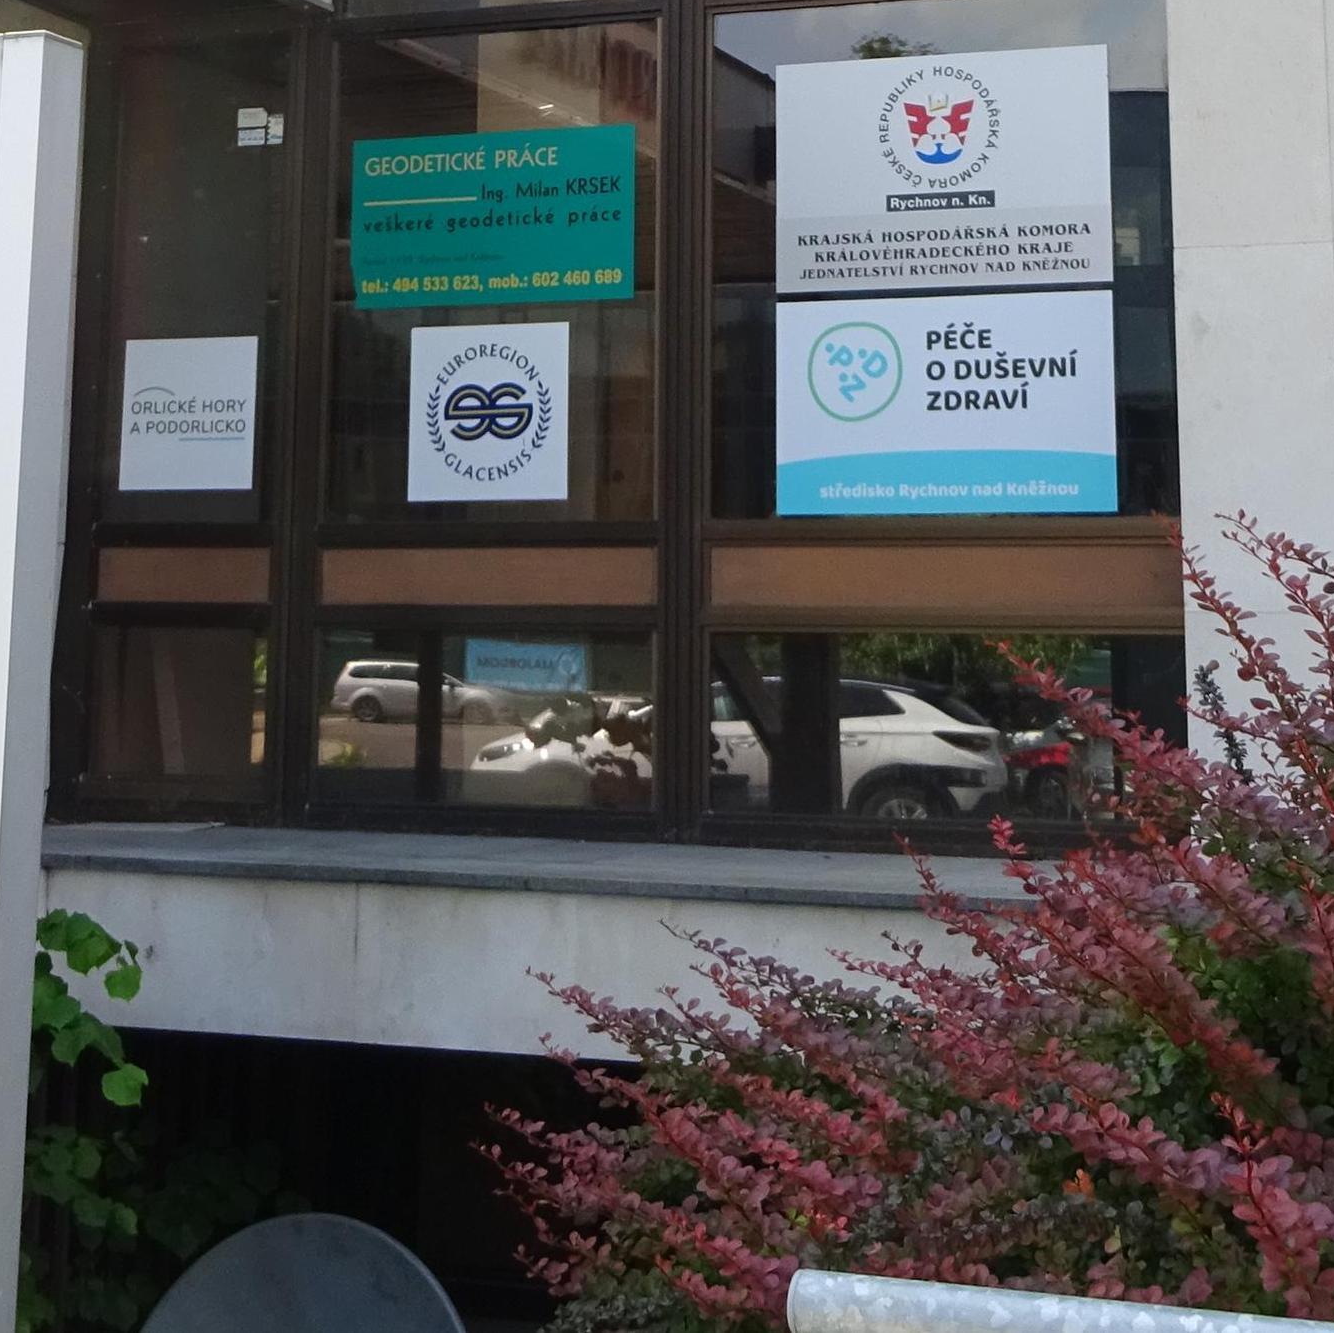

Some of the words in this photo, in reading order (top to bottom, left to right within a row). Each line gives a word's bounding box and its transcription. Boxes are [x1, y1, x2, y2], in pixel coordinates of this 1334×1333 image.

[879, 70, 924, 143] REPUBLIKY
[934, 66, 1000, 149] HOSPODÁŘSKÁ
[366, 146, 485, 176] GEODETICKÉ
[495, 143, 558, 167] PRÁCE
[880, 148, 922, 187] ČESKÉ
[929, 153, 989, 189] KOMORA
[482, 183, 508, 203] Ing.
[517, 182, 558, 197] Milan
[566, 176, 620, 195] KRSEK
[890, 195, 947, 210] Rychnov
[952, 197, 964, 207] n.
[968, 194, 990, 206] Kn.
[364, 209, 433, 234] veškeré
[447, 206, 554, 232] geodetické
[568, 205, 621, 225] práce
[798, 229, 873, 246] KRAJSKÁ
[882, 224, 1009, 243] HOSPODÁŘSKÁ
[1017, 223, 1091, 237] KOMORA
[815, 243, 1009, 263] KRÁLOVÉHRADECKÉHO
[1018, 241, 1073, 255] KRAJE
[489, 274, 528, 288] mob.:
[799, 263, 903, 279] JEDNATELSTVÍ
[910, 262, 979, 276] RYCHNOV
[985, 260, 1015, 273] NAD
[1022, 257, 1091, 271] KNĚŽNOU
[926, 322, 992, 350] PÉČE
[439, 344, 539, 386] EUROREGION
[926, 361, 945, 380] O
[955, 349, 1077, 379] DUŠEVNÍ
[131, 396, 197, 415] ORLICKÉ
[202, 399, 246, 413] HORY
[926, 383, 1029, 411] ZDRAVÍ
[130, 421, 140, 434] A
[146, 419, 245, 434] PODORLICKO
[444, 449, 533, 481] GLACENSIS
[820, 483, 895, 498] středisko
[899, 482, 968, 499] Rychnov
[972, 482, 1002, 496] nad
[1007, 480, 1078, 496] Kněžnou
